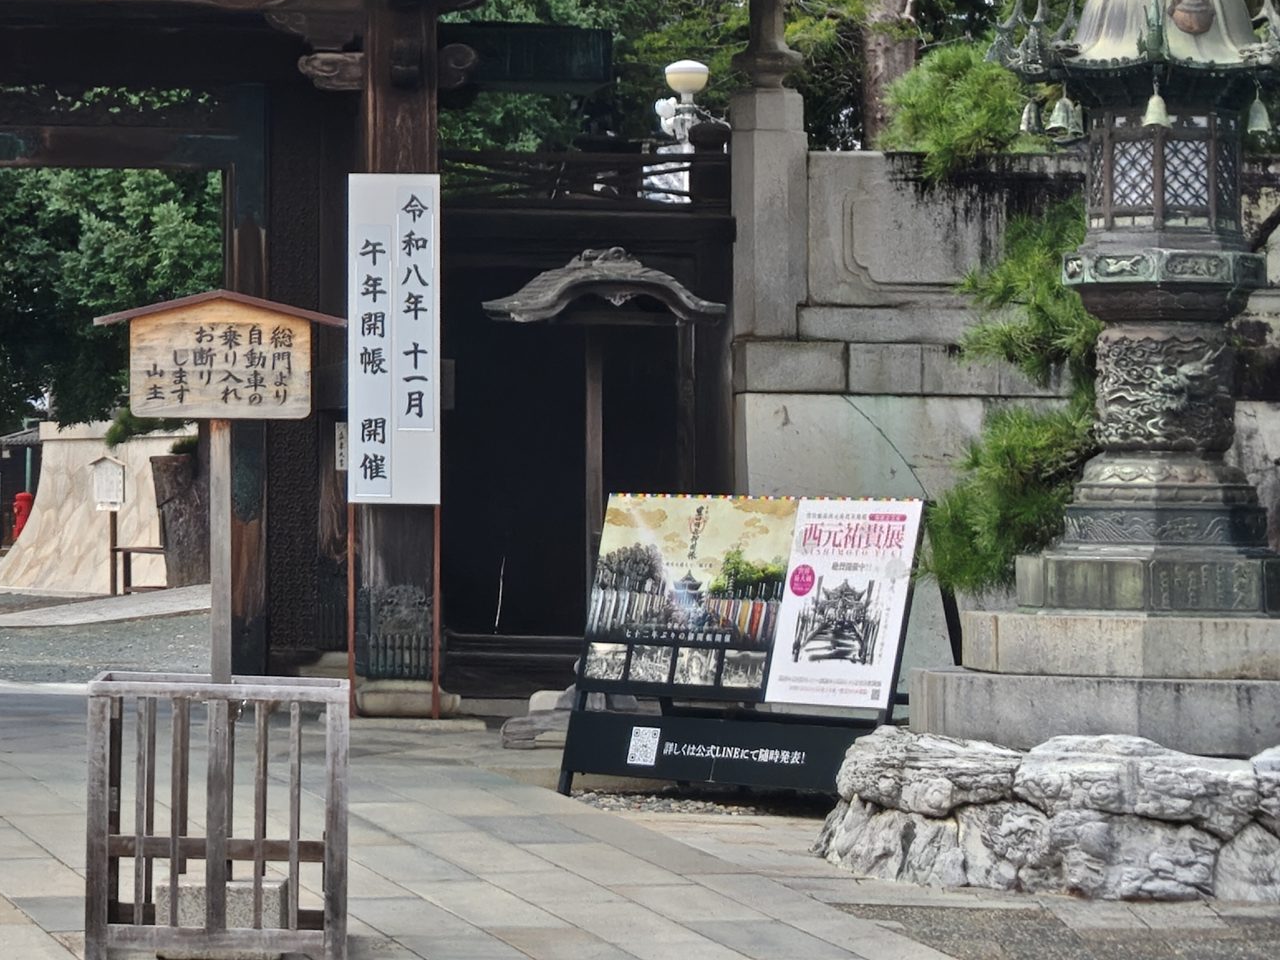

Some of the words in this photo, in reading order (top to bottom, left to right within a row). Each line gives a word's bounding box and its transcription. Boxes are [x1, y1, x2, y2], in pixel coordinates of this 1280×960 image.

[401, 194, 429, 321] 令和八年
[359, 239, 388, 375] 午年開帳
[146, 363, 165, 401] 山主
[170, 348, 190, 405] します
[193, 326, 217, 386] お断り
[219, 325, 243, 405] 乗り入れ
[244, 325, 267, 405] 自動車の
[270, 325, 294, 405] 総門より
[402, 342, 429, 419] 十一月
[359, 417, 388, 481] 開催
